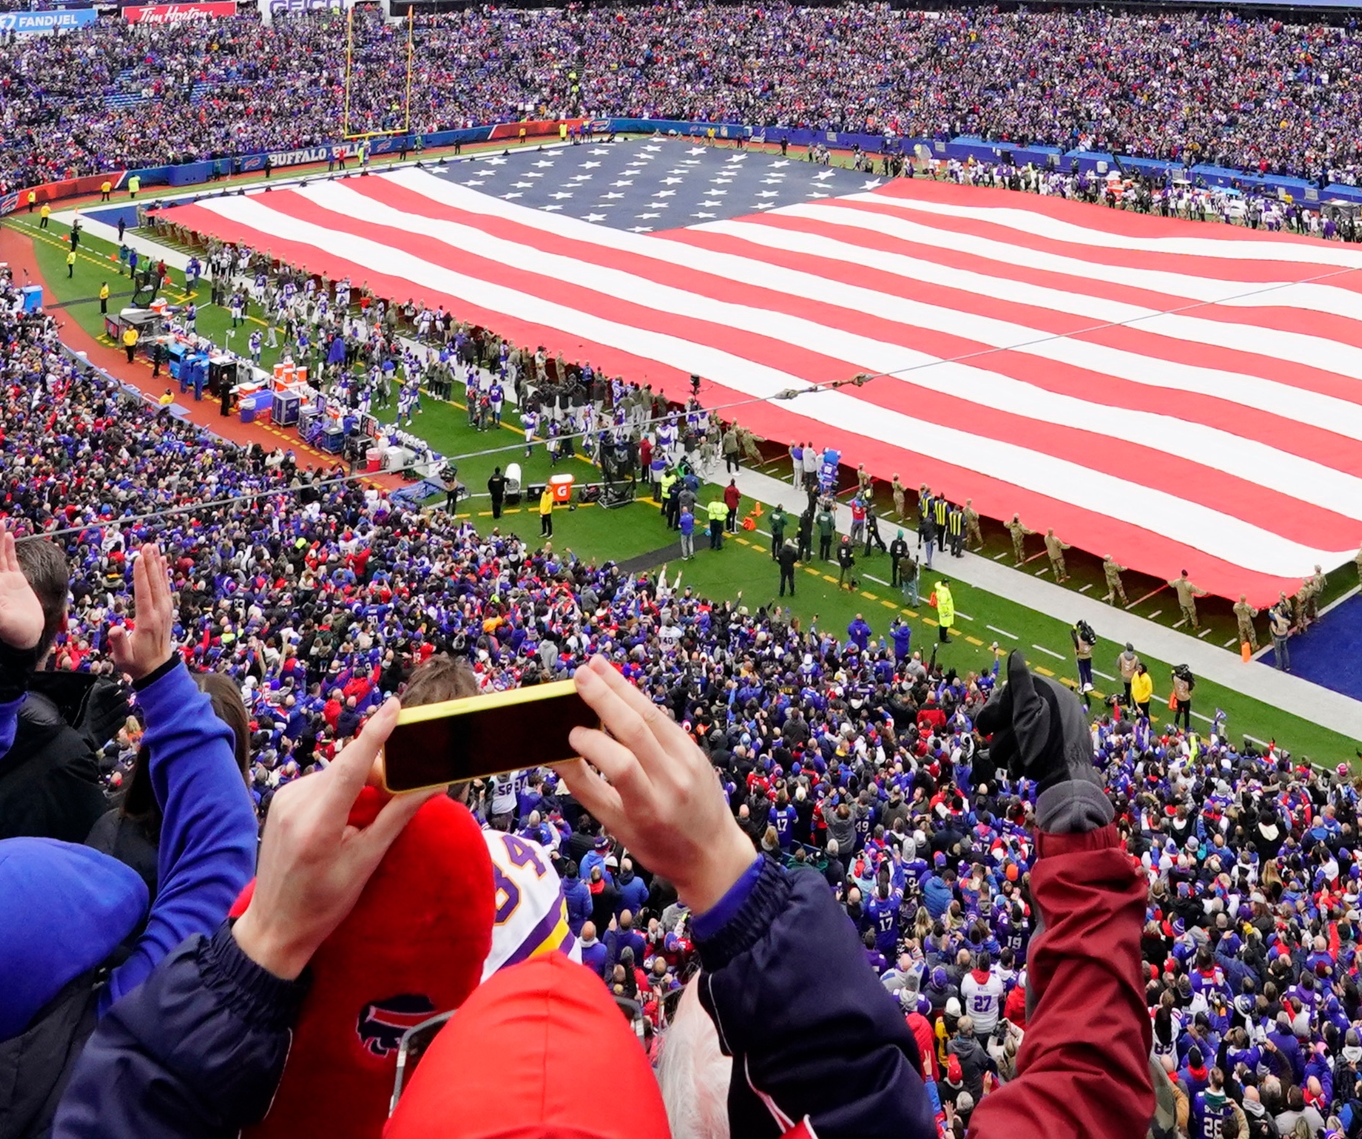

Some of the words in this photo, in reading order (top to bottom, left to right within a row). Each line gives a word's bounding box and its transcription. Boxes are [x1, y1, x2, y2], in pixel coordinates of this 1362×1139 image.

[19, 14, 78, 29] FANDUEL
[139, 7, 163, 24] Tim
[161, 4, 213, 24] Hortons
[269, 148, 327, 168] BUFFALO
[498, 782, 512, 796] 58
[776, 818, 788, 832] 17
[855, 820, 868, 833] 49
[879, 917, 893, 932] 17
[1200, 987, 1215, 1002] 14
[974, 995, 991, 1012] 27
